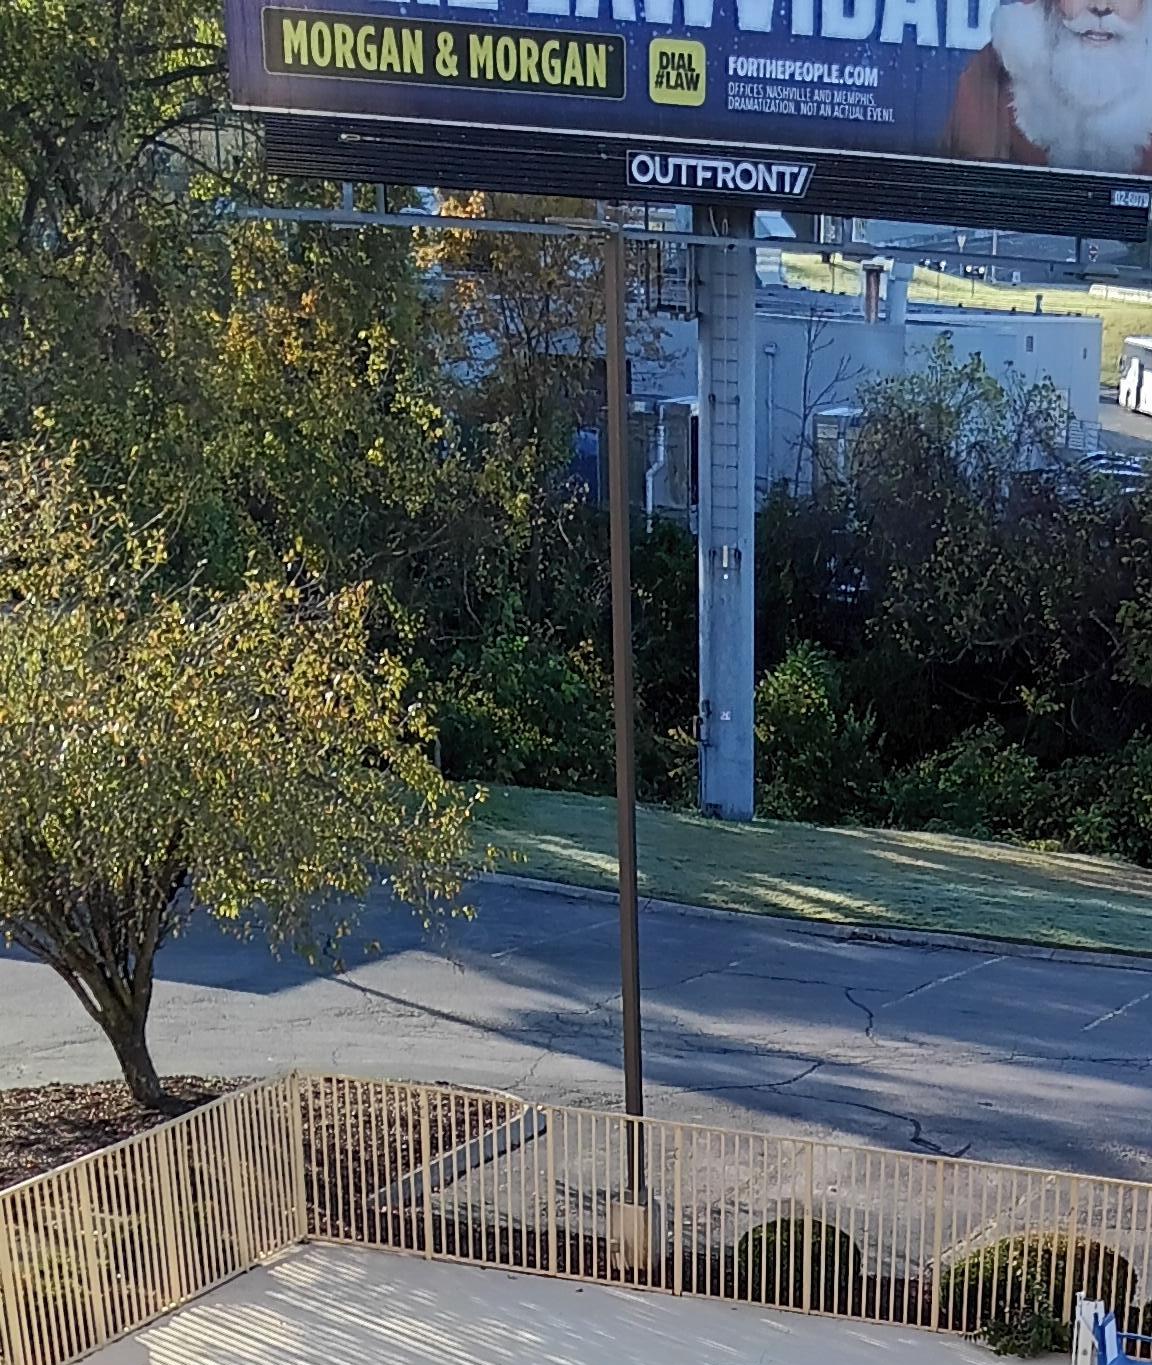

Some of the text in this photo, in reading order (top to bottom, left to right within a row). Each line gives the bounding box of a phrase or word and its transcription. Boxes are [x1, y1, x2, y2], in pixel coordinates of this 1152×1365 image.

[283, 18, 608, 88] MORGAN & MORGAN
[658, 51, 696, 73] DIAL
[654, 70, 700, 92] #LAW
[728, 56, 878, 87] FORTHEPEOPLE.COM
[728, 81, 764, 98] OFFICES
[766, 85, 811, 102] NASHVILLE
[813, 89, 832, 103] AND
[800, 102, 817, 116] NOT
[819, 104, 832, 117] AN
[833, 105, 865, 120] ACTUAL
